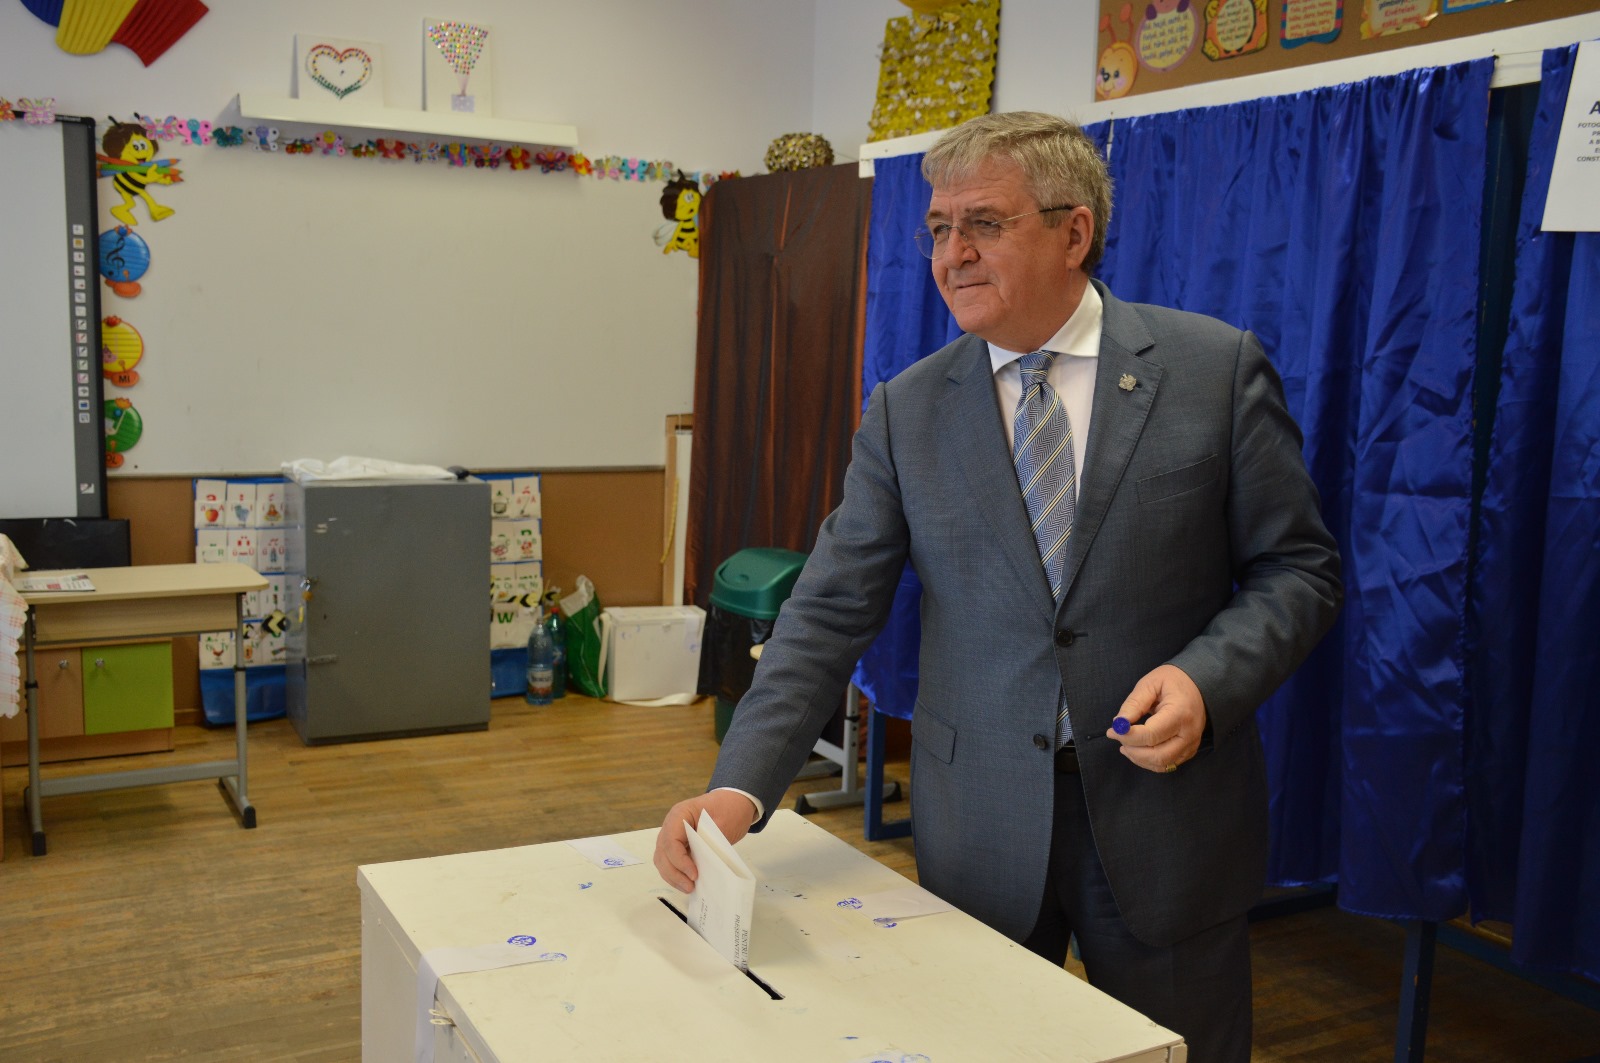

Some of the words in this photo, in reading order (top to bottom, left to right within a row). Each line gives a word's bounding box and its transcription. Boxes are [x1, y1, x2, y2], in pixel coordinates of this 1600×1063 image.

[119, 375, 130, 383] MI
[106, 454, 117, 465] OL
[497, 612, 514, 624] W
